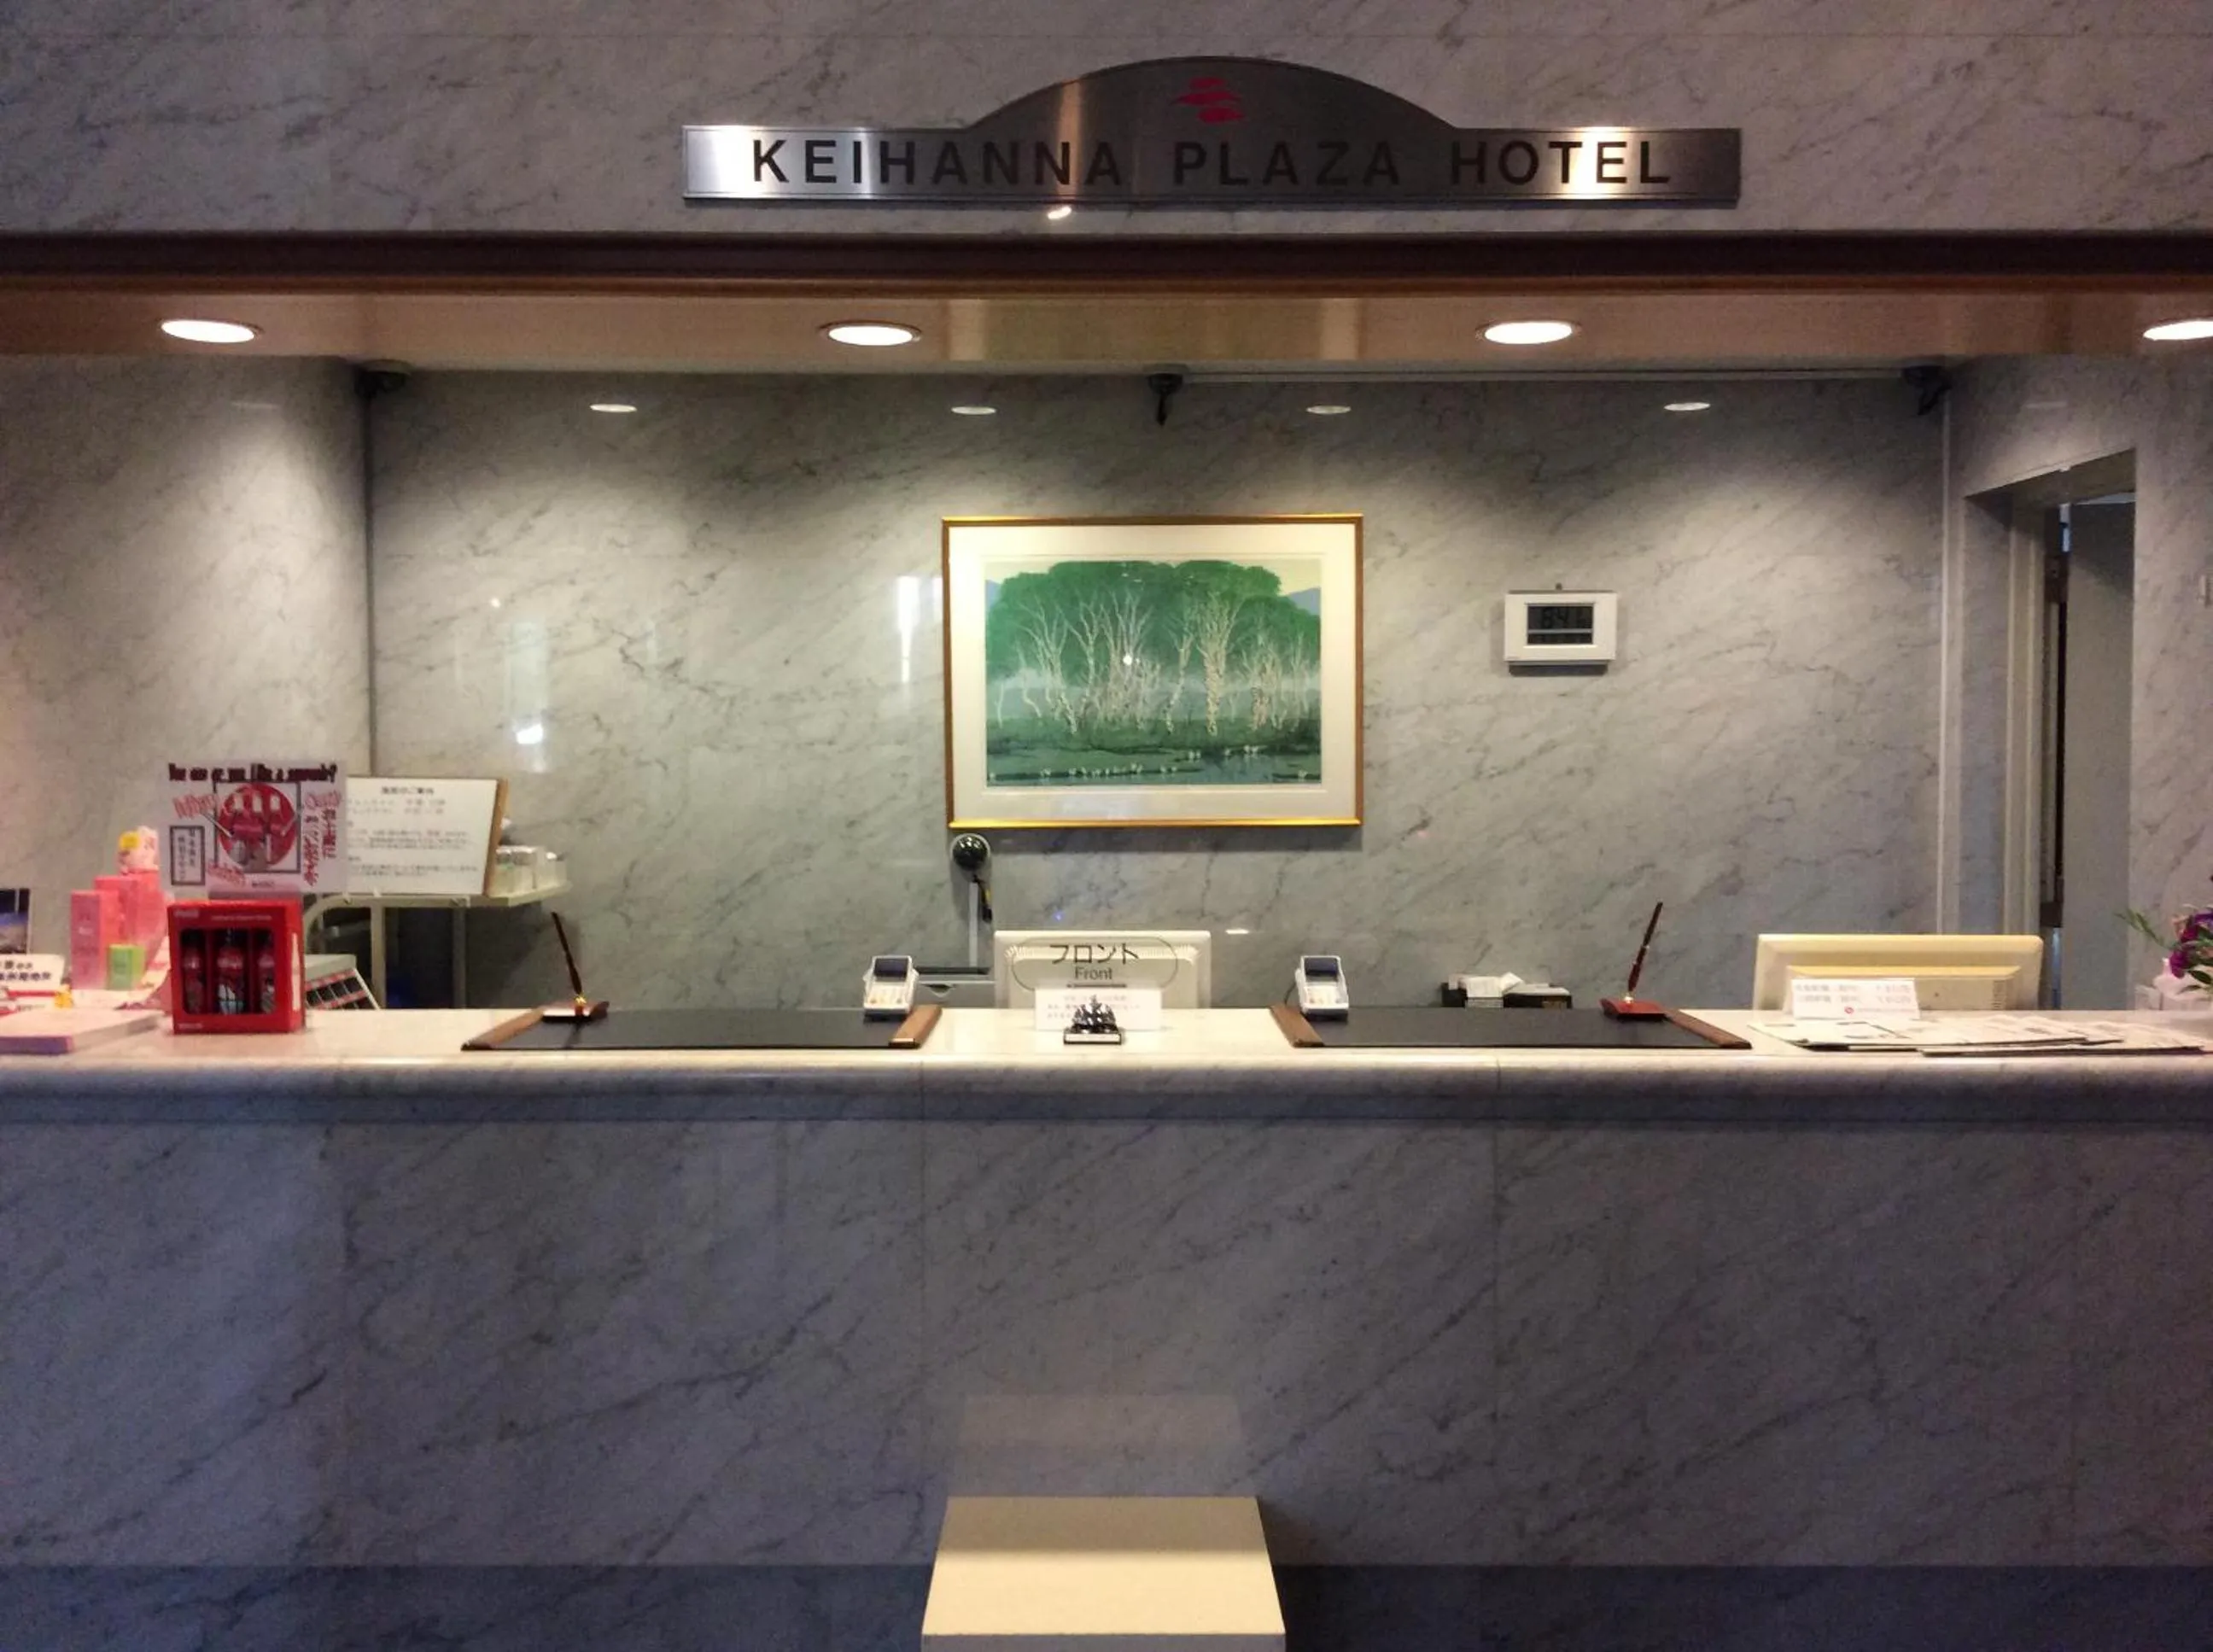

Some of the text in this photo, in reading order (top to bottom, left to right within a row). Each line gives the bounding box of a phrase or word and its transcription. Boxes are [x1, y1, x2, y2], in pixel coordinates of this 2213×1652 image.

[752, 138, 1673, 186] KEIHANNA PLAZA HOTEL
[1049, 943, 1139, 964] フロント
[1075, 966, 1112, 980] Front
